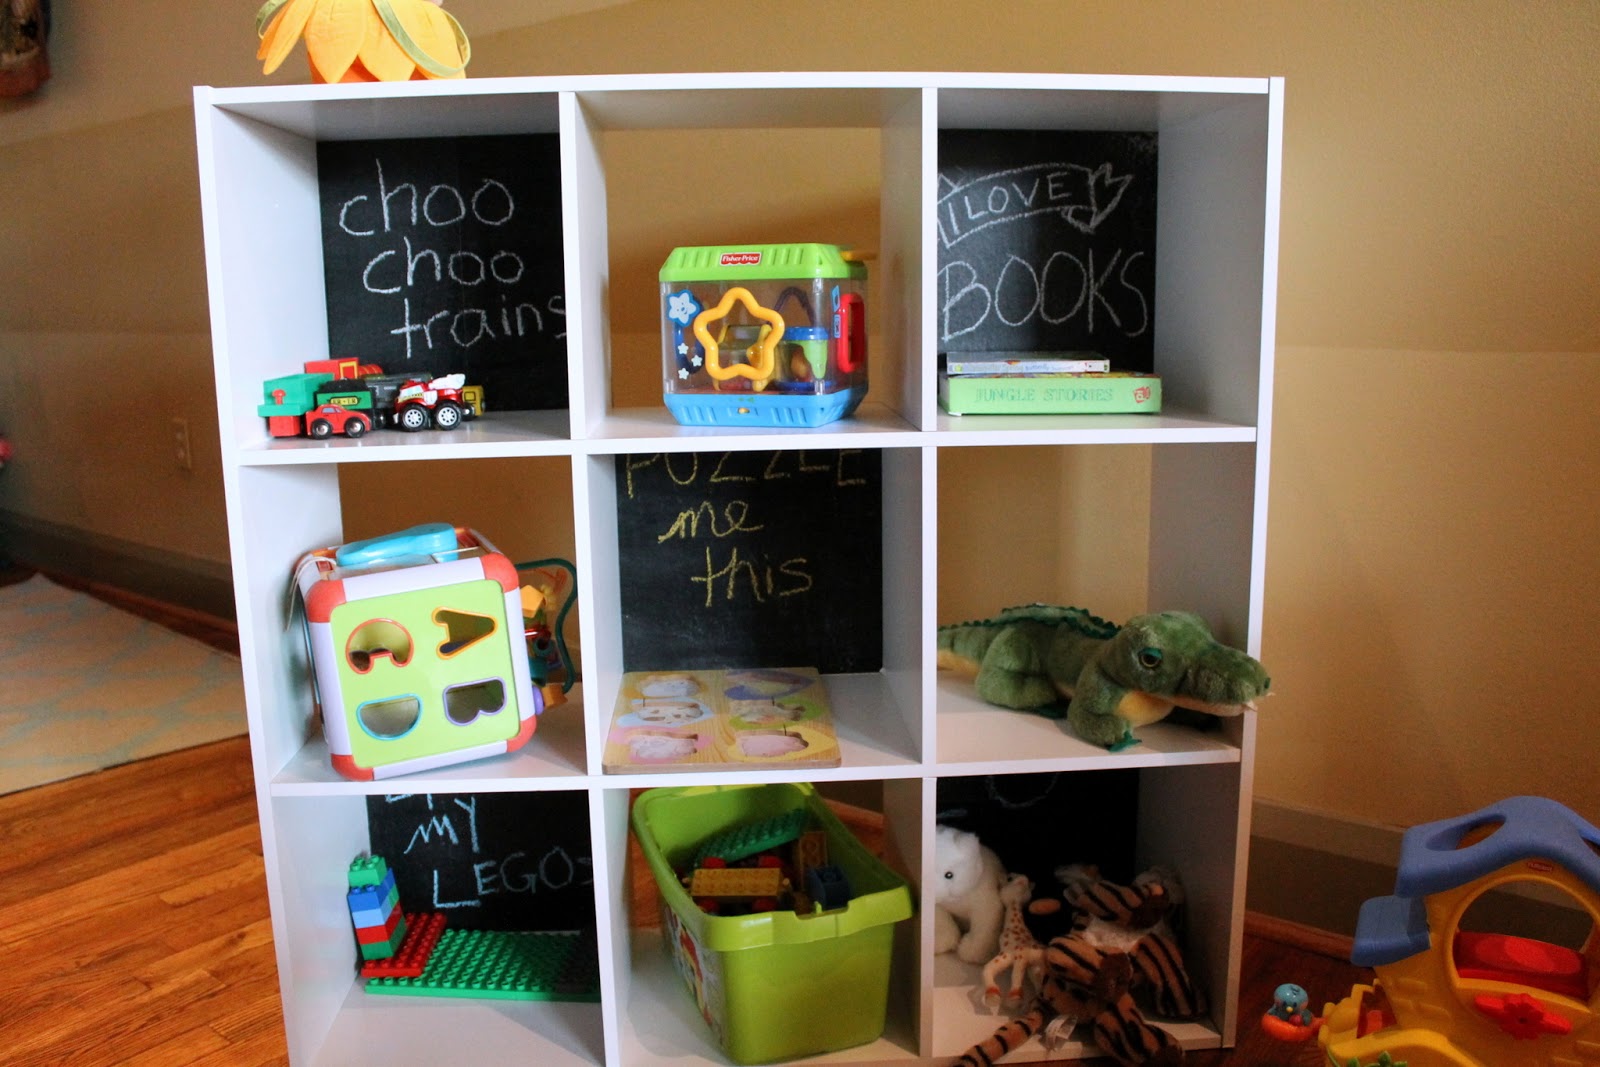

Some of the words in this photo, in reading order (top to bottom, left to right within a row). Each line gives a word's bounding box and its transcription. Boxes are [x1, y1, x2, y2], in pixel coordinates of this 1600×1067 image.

[338, 157, 514, 236] choo
[964, 171, 1073, 221] LOVE
[362, 235, 524, 294] choo
[937, 247, 1148, 343] BOOKS
[390, 294, 567, 360] trains
[975, 387, 1035, 403] JUNGLE
[1043, 387, 1114, 402] STORIES
[657, 500, 764, 544] me
[690, 546, 813, 608] this
